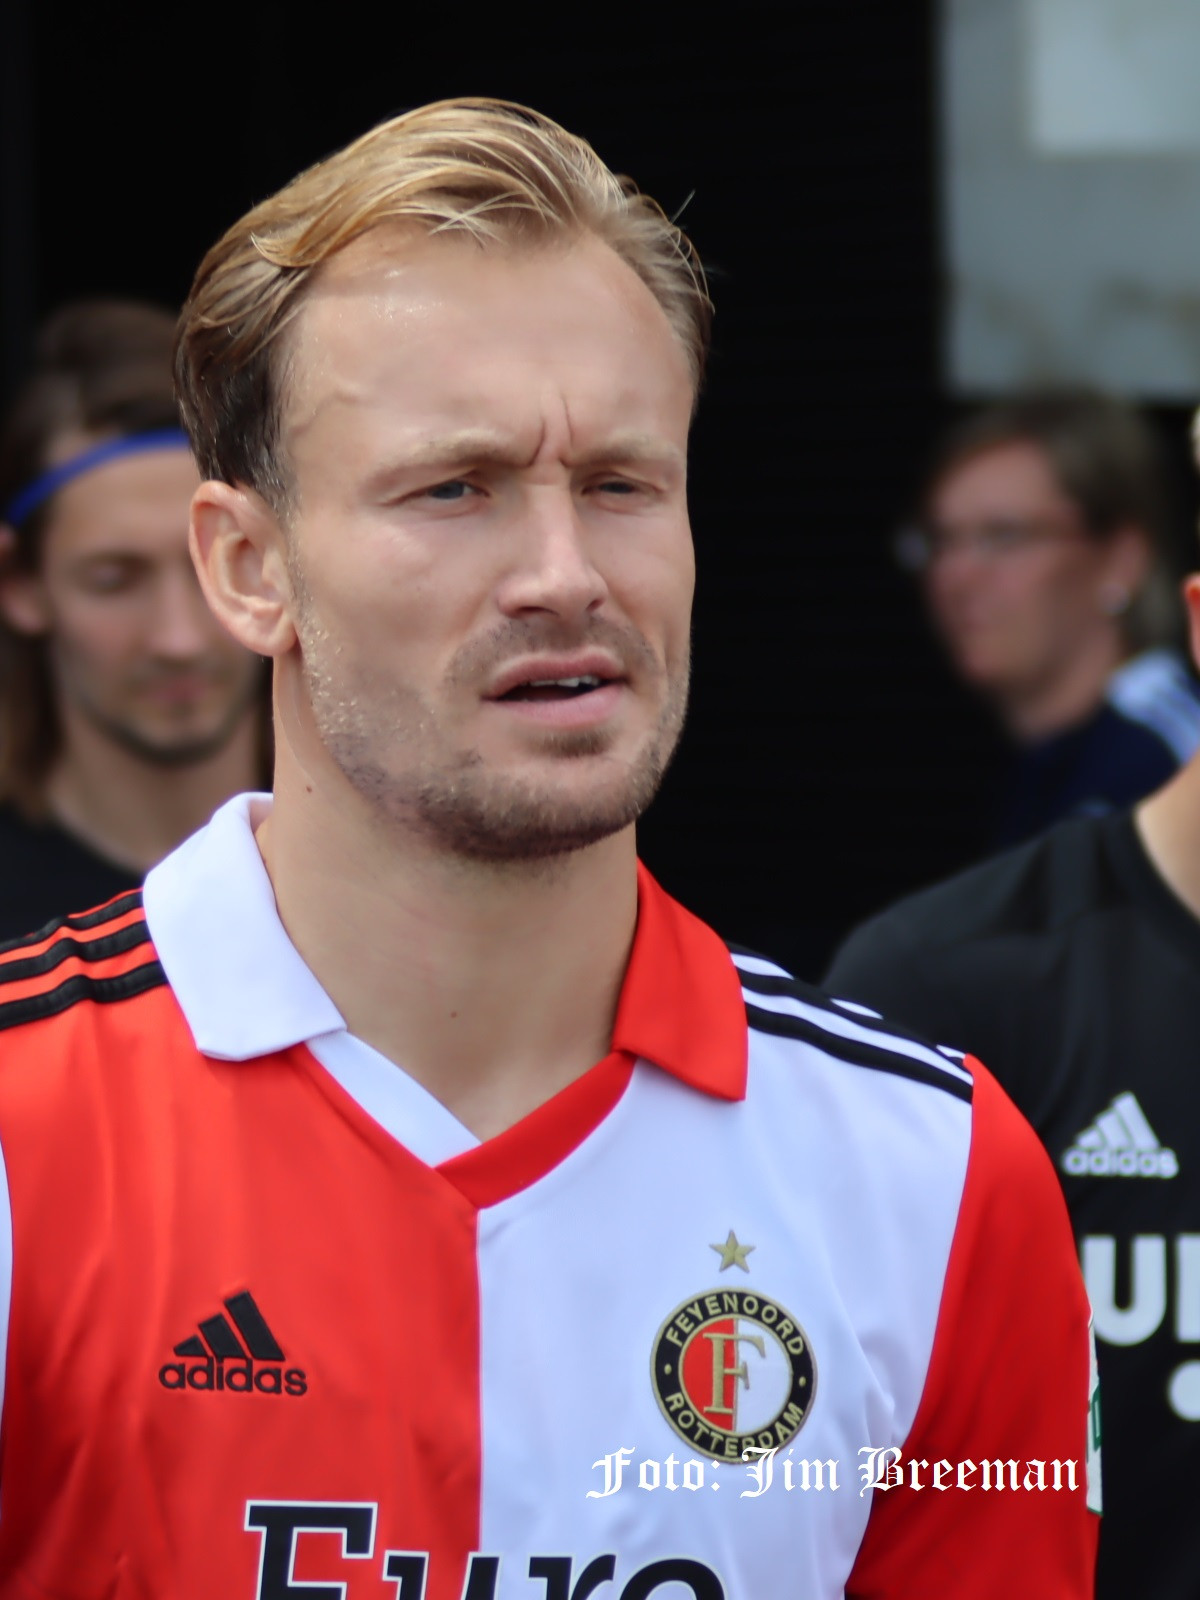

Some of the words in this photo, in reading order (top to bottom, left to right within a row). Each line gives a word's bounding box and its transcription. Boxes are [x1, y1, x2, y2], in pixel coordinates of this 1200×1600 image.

[1062, 1147, 1179, 1179] adidas
[665, 1292, 805, 1355] FEYENOORD
[158, 1356, 308, 1397] adidas
[665, 1392, 804, 1457] ROTTERDAM
